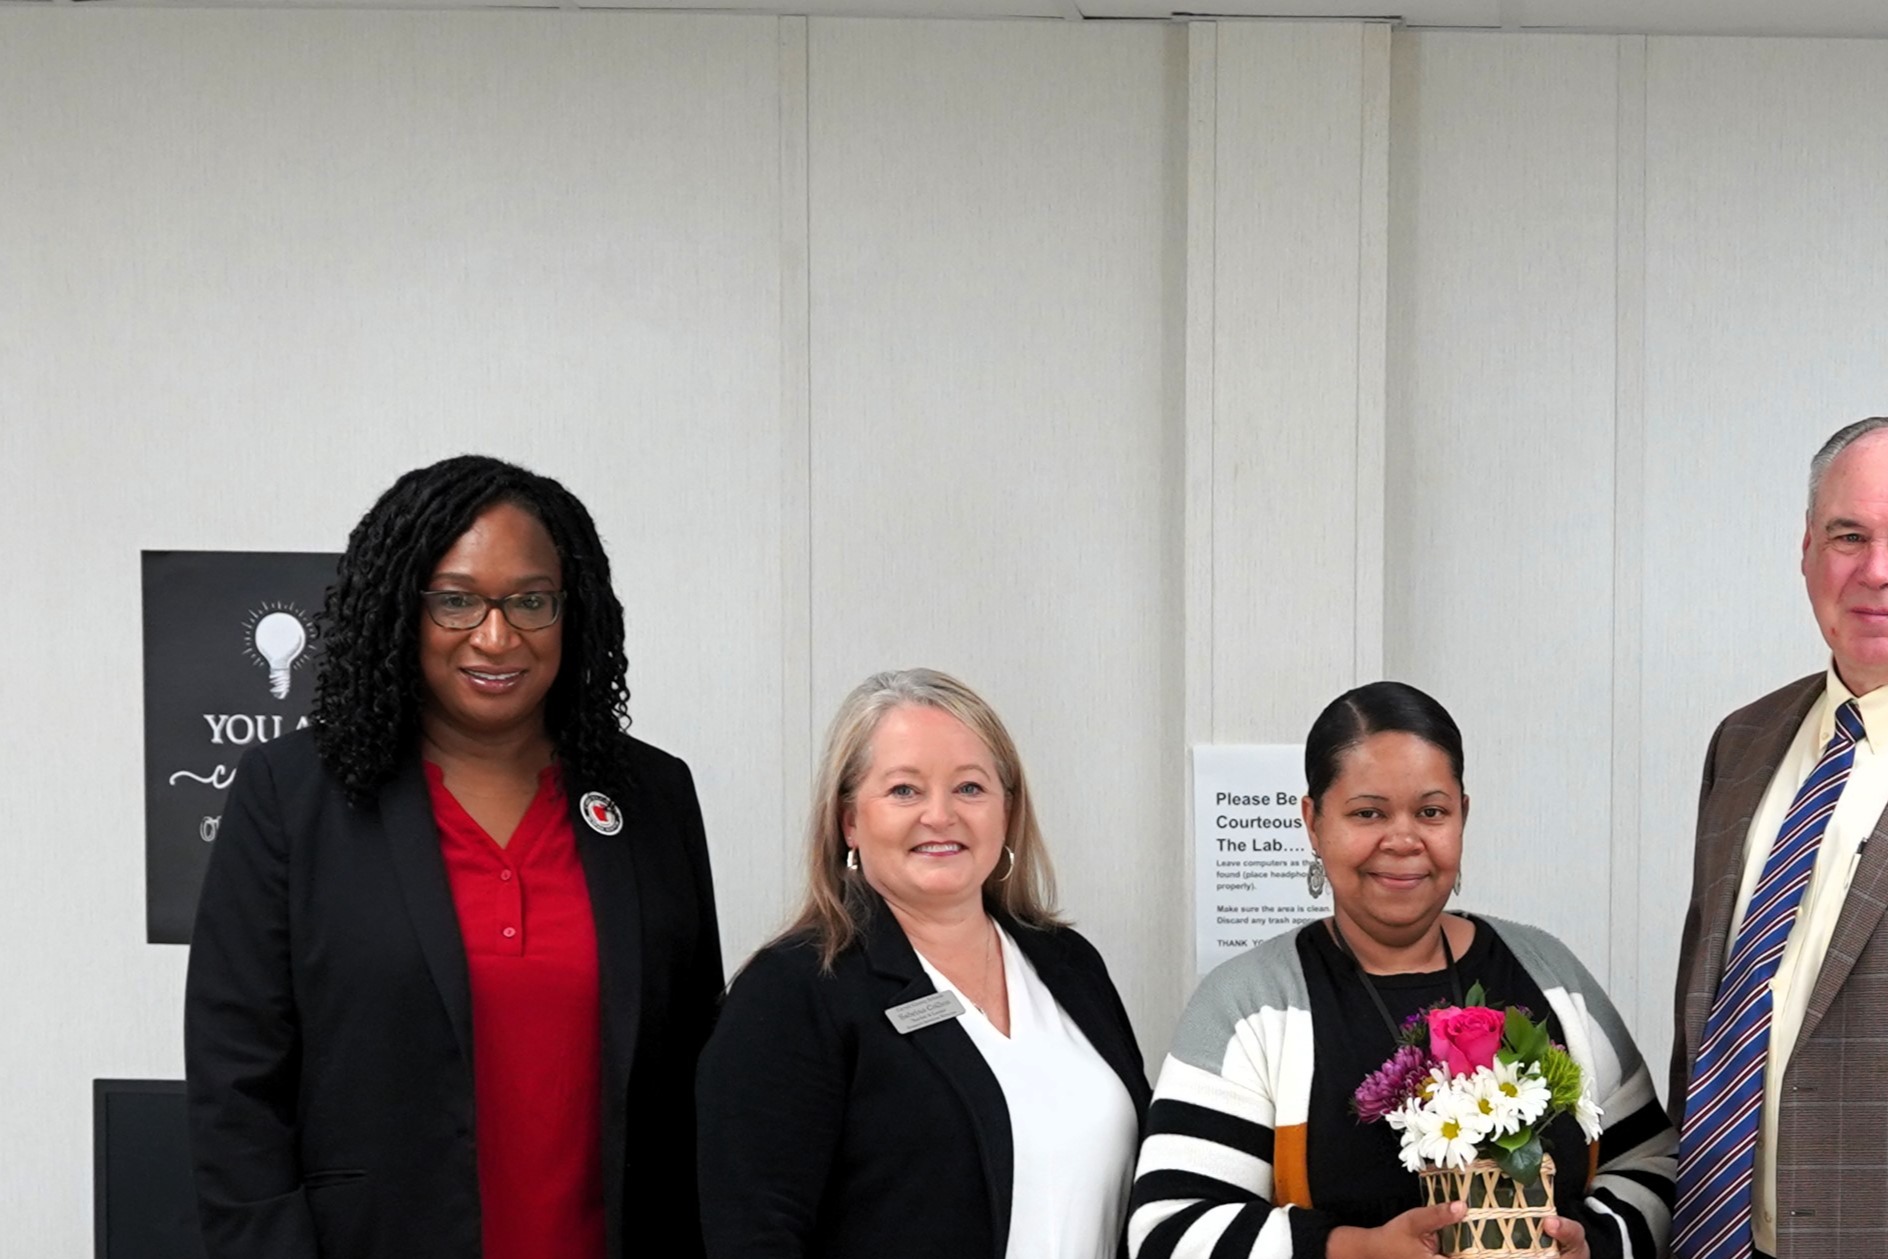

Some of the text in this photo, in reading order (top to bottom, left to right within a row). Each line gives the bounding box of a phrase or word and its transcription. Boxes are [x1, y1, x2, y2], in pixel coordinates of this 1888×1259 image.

[203, 714, 283, 744] YOU
[1216, 792, 1298, 806] Please Be
[1216, 815, 1303, 829] Courteous
[1216, 838, 1247, 852] The
[1243, 860, 1288, 868] computers
[1243, 871, 1268, 879] (place
[1216, 916, 1249, 924] Discard
[1251, 917, 1266, 926] any
[1268, 916, 1290, 924] trash
[1217, 939, 1248, 947] THANK
